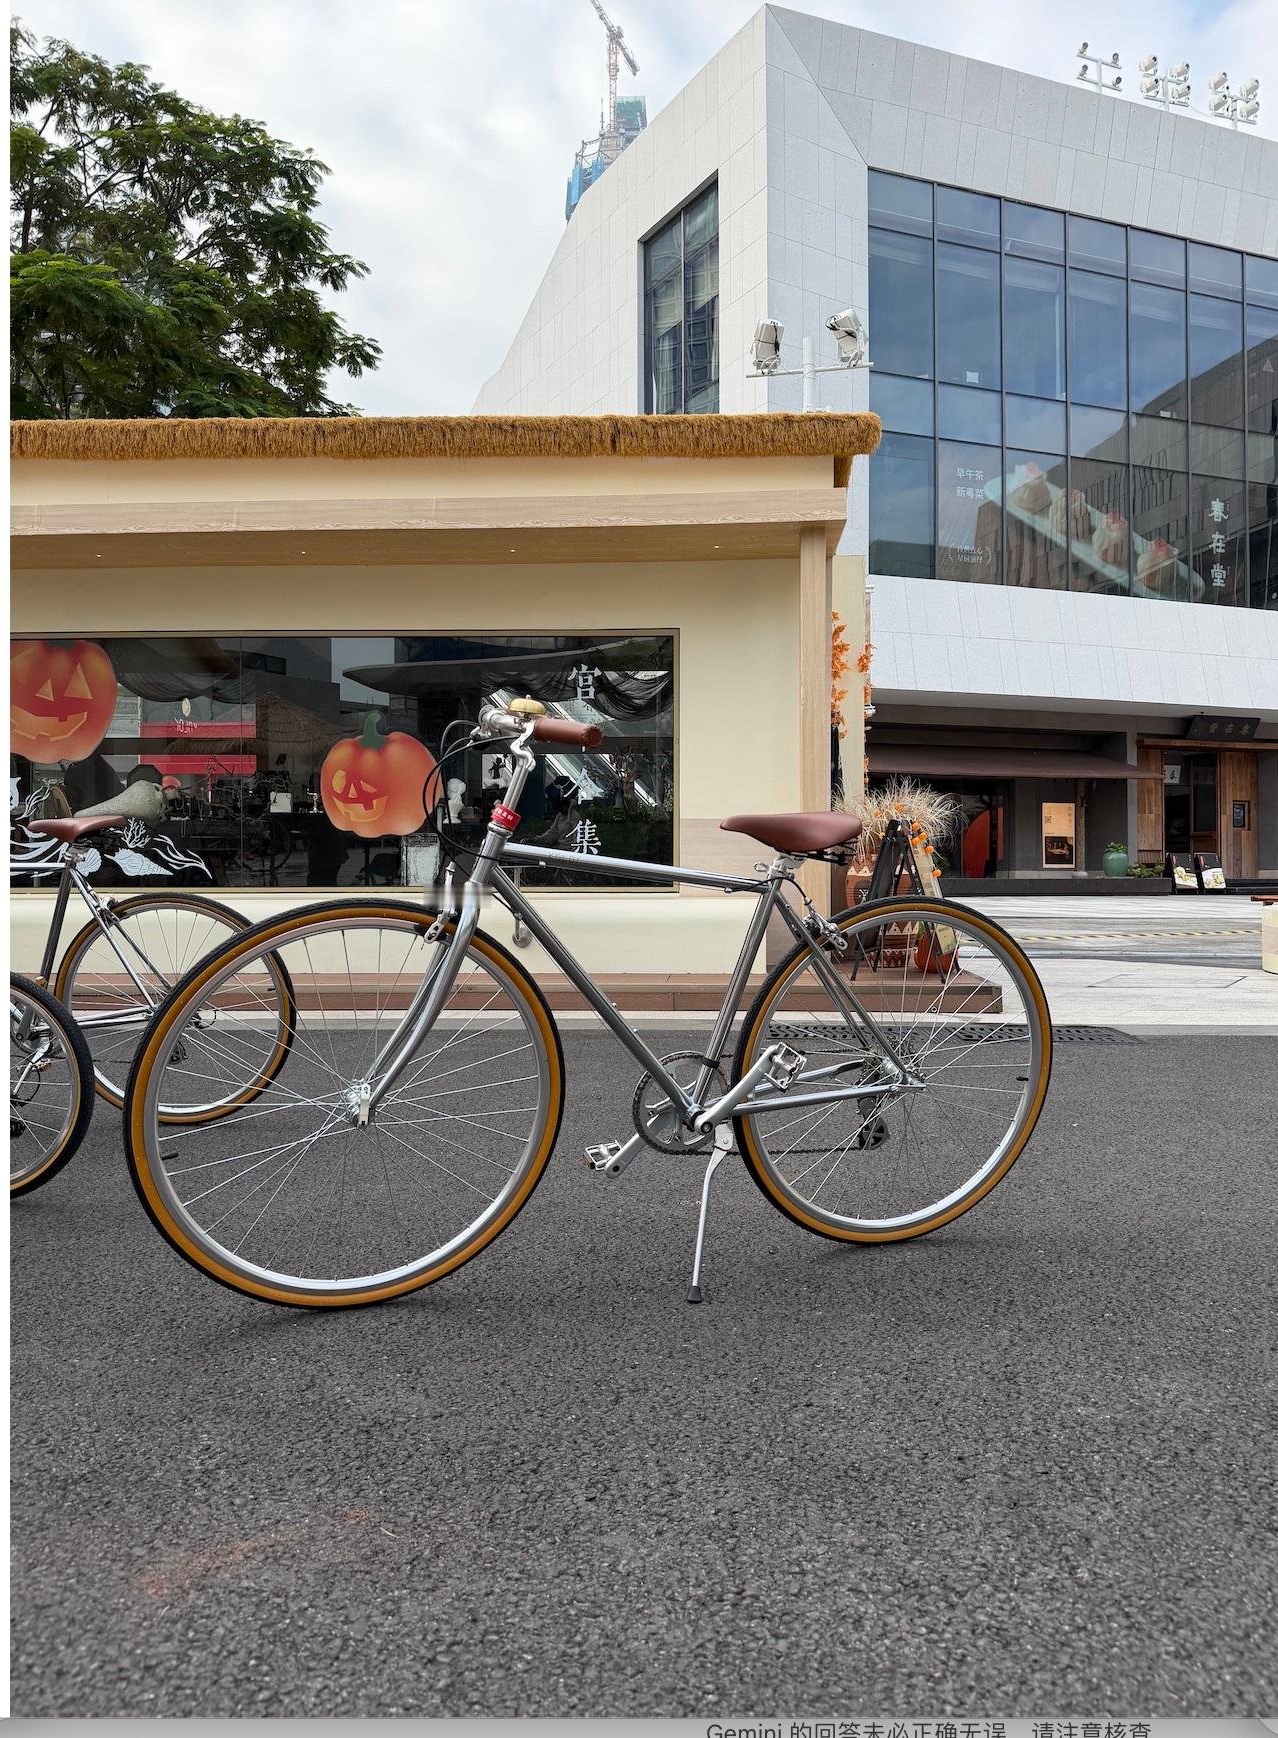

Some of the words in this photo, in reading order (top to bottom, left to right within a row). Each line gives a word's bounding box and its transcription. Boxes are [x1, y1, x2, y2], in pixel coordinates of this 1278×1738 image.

[956, 467, 985, 481] 早午茶
[1208, 498, 1229, 587] 春在堂
[707, 1722, 782, 1738] Gemini
